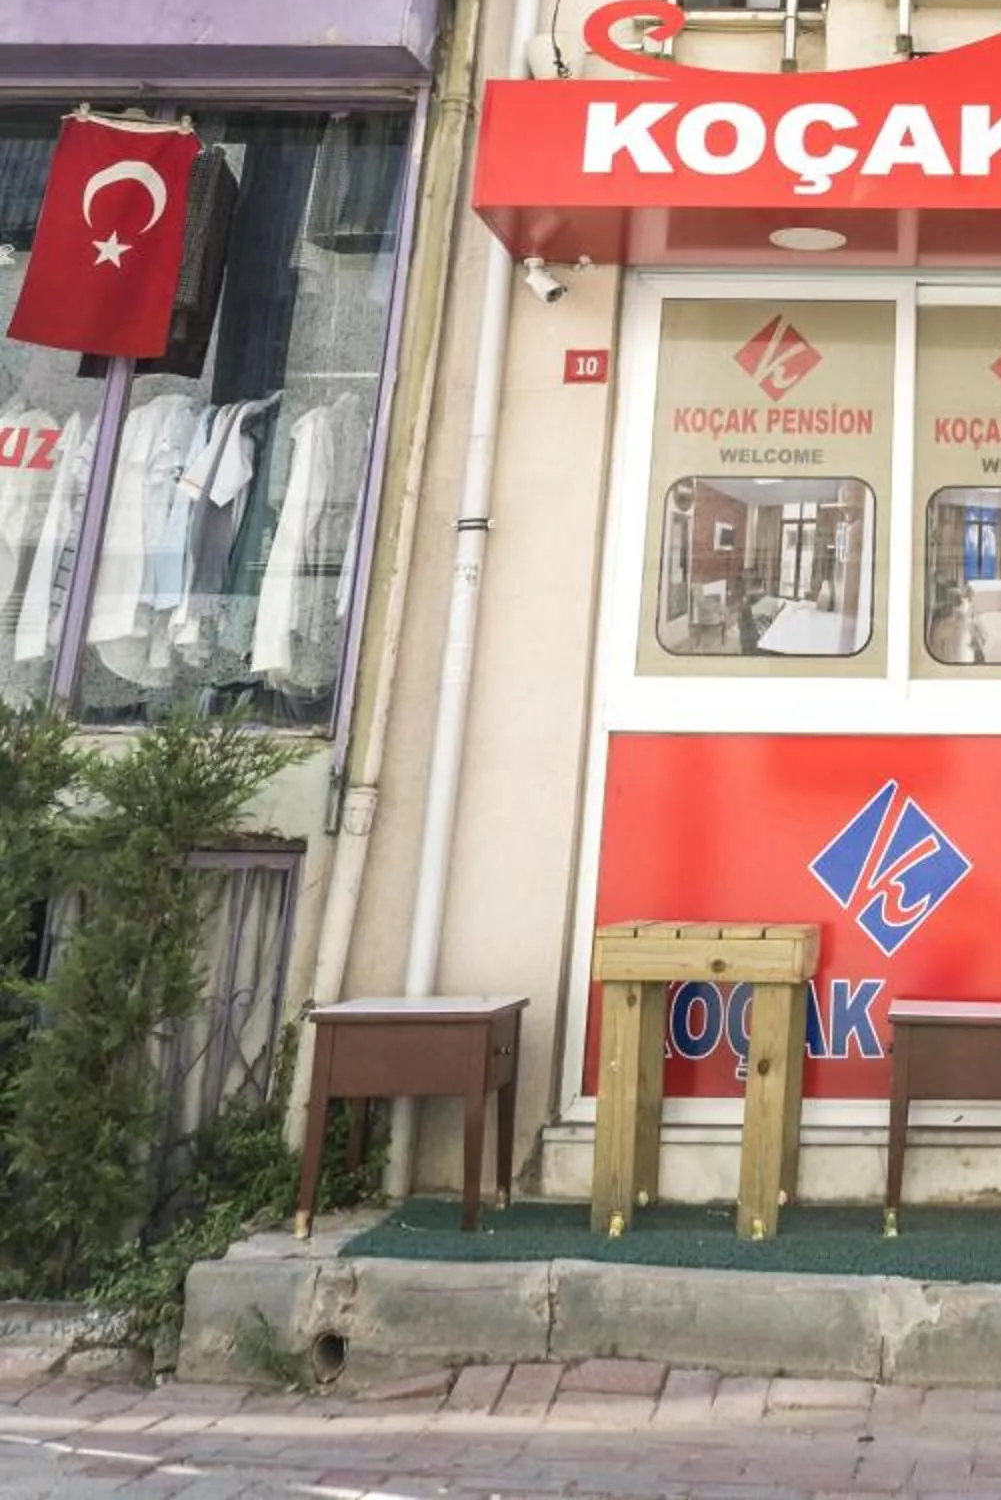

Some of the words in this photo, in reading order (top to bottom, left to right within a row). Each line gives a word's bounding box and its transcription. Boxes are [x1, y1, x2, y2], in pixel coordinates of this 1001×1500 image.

[575, 356, 599, 376] 10
[673, 407, 759, 440] KOÇAK
[719, 447, 825, 464] WELCOME
